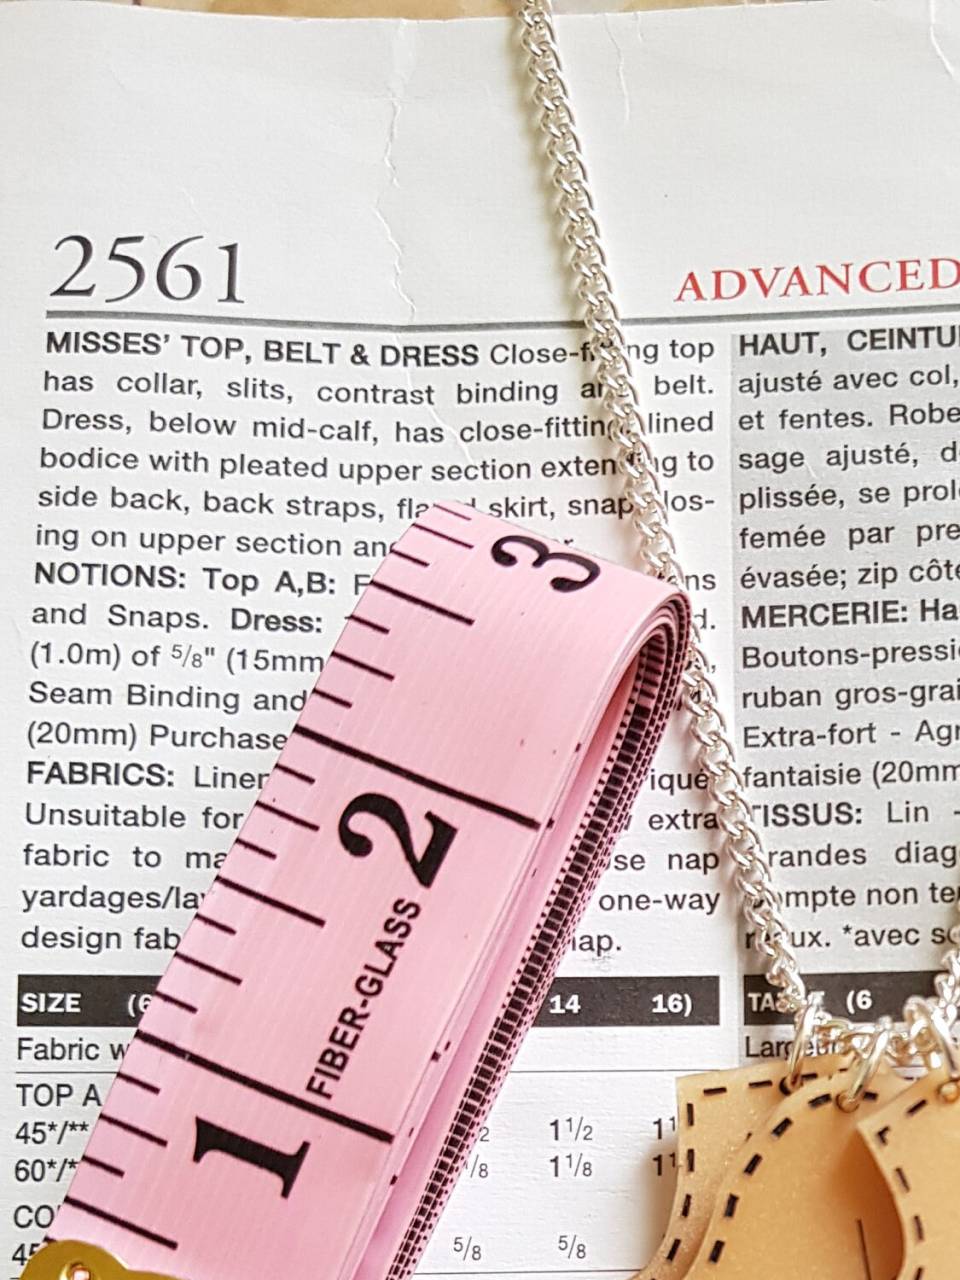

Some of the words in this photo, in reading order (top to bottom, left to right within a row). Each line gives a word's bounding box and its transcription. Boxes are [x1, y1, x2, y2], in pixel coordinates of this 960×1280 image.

[49, 234, 245, 304] 2561
[46, 330, 170, 356] MISSES'
[180, 334, 252, 365] TOP,
[263, 339, 342, 365] BELT
[350, 343, 371, 366] &
[380, 343, 479, 368] DRESS
[669, 339, 715, 364] top
[739, 331, 827, 358] HAUT,
[43, 369, 94, 392] has
[116, 371, 203, 400] collar,
[226, 376, 293, 405] slits,
[317, 383, 435, 406] contrast
[456, 380, 558, 406] binding
[654, 373, 714, 396] belt.
[738, 369, 823, 399] ajusté
[832, 371, 898, 391] avec
[909, 363, 959, 389] col,
[42, 408, 132, 435] Dress,
[149, 411, 237, 436] below
[252, 416, 378, 446] mid-calf,
[395, 420, 445, 444] has
[648, 410, 714, 434] lined
[738, 410, 765, 431] et
[778, 408, 873, 430] fentes.
[40, 446, 139, 470] bodice
[148, 450, 209, 473] with
[220, 453, 328, 480] pleated
[339, 463, 423, 486] upper
[431, 458, 531, 481] section
[686, 450, 714, 472] to
[738, 451, 805, 475] sage
[825, 441, 919, 472] ajusté,
[37, 485, 98, 508] side
[110, 485, 190, 516] back,
[203, 490, 274, 515] back
[286, 495, 384, 523] straps,
[739, 483, 845, 515] plissée,
[858, 486, 891, 504] se
[36, 524, 79, 552] ing
[90, 529, 127, 548] on
[139, 532, 227, 556] upper
[236, 532, 342, 556] section
[738, 523, 826, 550] femée
[848, 525, 896, 551] par
[34, 561, 186, 589] NOTIONS:
[201, 567, 259, 597] Top
[274, 570, 335, 598] A,B:
[490, 534, 601, 594] 3
[740, 563, 847, 590] évasée;
[857, 562, 898, 590] zip
[31, 603, 87, 625] and
[107, 603, 209, 634] Snaps.
[231, 607, 322, 634] Dress:
[741, 599, 908, 629] MERCERIE:
[30, 640, 121, 672] (1.0m)
[131, 644, 161, 667] of
[28, 680, 112, 705] Seam
[127, 683, 240, 715] Binding
[742, 685, 822, 709] ruban
[27, 720, 137, 752] (20mm)
[743, 722, 877, 749] Extra-fort
[27, 760, 174, 787] FABRICS:
[742, 762, 862, 788] fantaisie
[25, 802, 187, 829] Unsuitable
[201, 806, 244, 830] for
[887, 800, 929, 824] Lin
[337, 792, 459, 889] 2
[22, 843, 110, 868] fabric
[132, 846, 162, 868] to
[668, 851, 720, 876] nap
[598, 891, 721, 916] one-way
[866, 887, 919, 906] non
[21, 925, 122, 955] design
[20, 992, 82, 1013] SIZE
[549, 994, 582, 1014] 14
[651, 993, 692, 1018] 16)
[304, 895, 424, 1101] FIBER-GLASS
[846, 989, 873, 1015] (6
[17, 1036, 100, 1061] Fabric
[15, 1082, 74, 1108] TOP
[192, 1115, 311, 1200] 1
